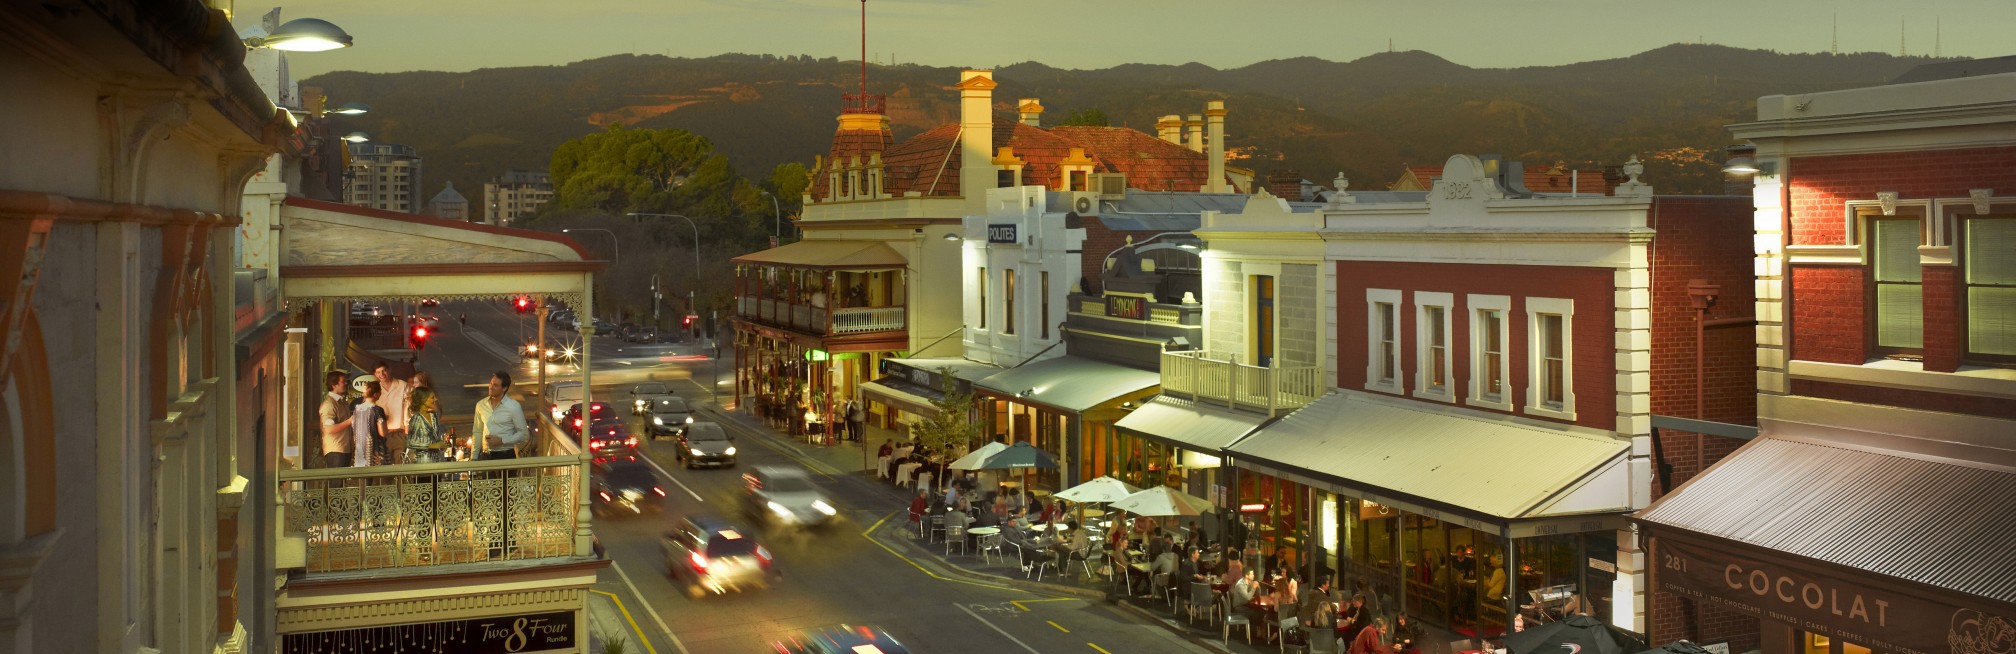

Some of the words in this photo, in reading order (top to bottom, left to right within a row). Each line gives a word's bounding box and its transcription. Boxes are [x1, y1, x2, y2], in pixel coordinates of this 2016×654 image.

[990, 227, 1015, 241] POLITES
[1665, 554, 1687, 573] 281
[1725, 563, 1889, 628] COCOLAT
[1665, 582, 1685, 593] COFFEE
[1693, 590, 1703, 598] TEA
[1710, 595, 1722, 603] HOT
[1724, 599, 1761, 614] CHOCOLATE
[1769, 610, 1797, 624] TRUFFLES
[1805, 621, 1828, 632] CAKES
[1836, 629, 1862, 642] CREPES
[1872, 639, 1892, 650] FULLY
[481, 623, 509, 642] Two
[504, 617, 528, 652] 8
[529, 618, 568, 638] Four
[546, 635, 568, 643] Rundle
